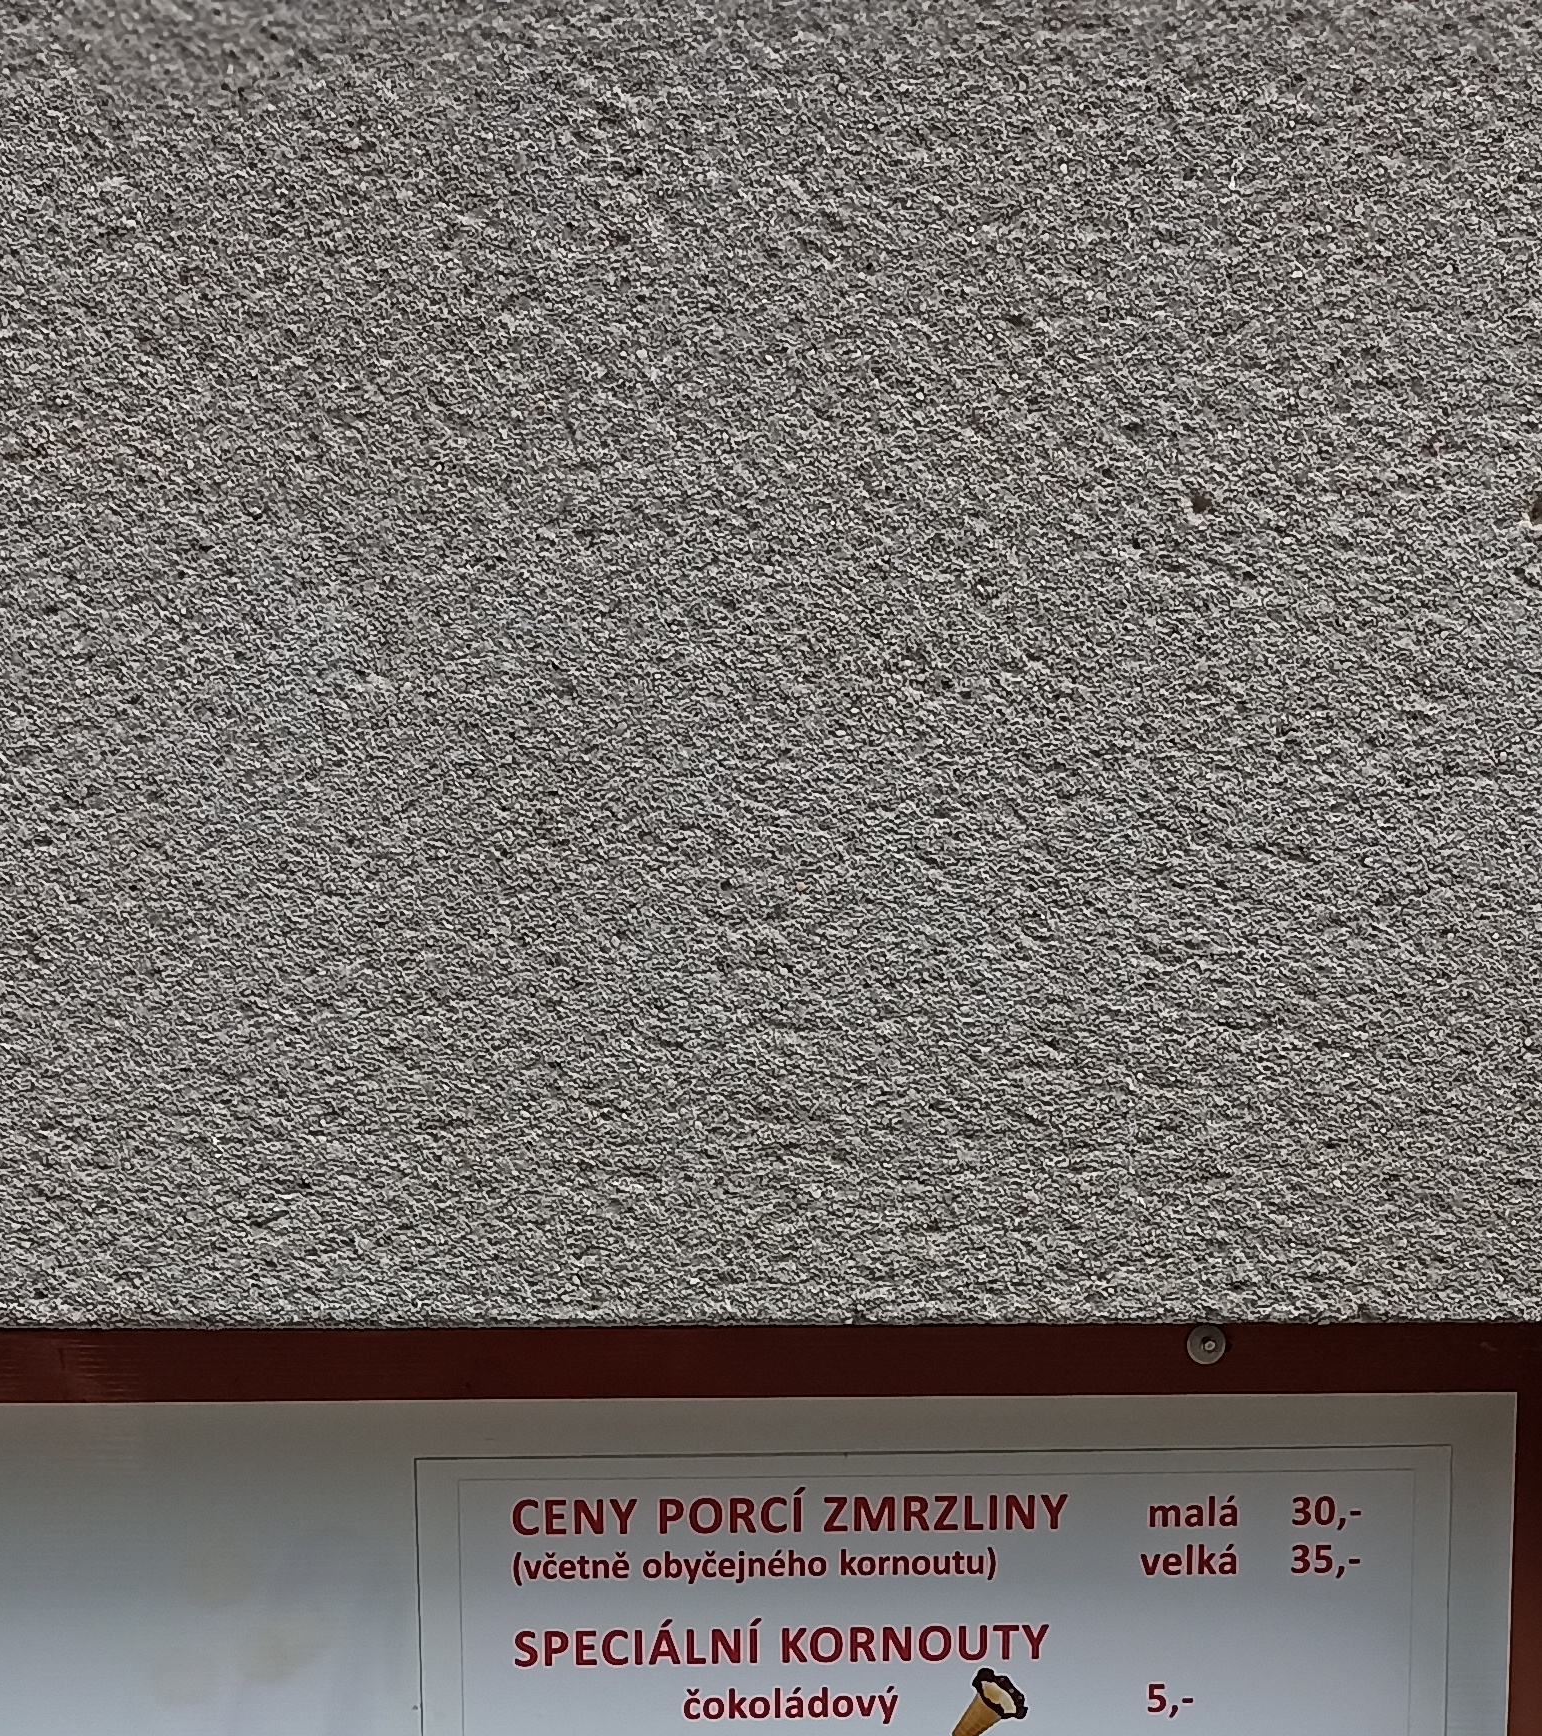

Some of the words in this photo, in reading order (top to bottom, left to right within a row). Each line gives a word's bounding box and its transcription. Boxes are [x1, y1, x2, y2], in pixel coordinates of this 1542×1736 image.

[513, 1499, 637, 1535] CENY
[660, 1487, 805, 1534] PORCÍ
[824, 1494, 1068, 1532] ZMRZLINY
[1150, 1495, 1237, 1527] malá
[1292, 1496, 1361, 1530] 30,-
[513, 1551, 629, 1586] (včetně
[643, 1549, 826, 1584] obyčejného
[841, 1547, 996, 1580] kornoutu)
[1141, 1544, 1236, 1575] velká
[1291, 1545, 1360, 1578] 35,-
[515, 1618, 761, 1667] SPECIÁLNÍ
[782, 1624, 1049, 1663] KORNOUTY
[684, 1686, 898, 1724] čokoládový
[1148, 1684, 1193, 1718] 5,-
